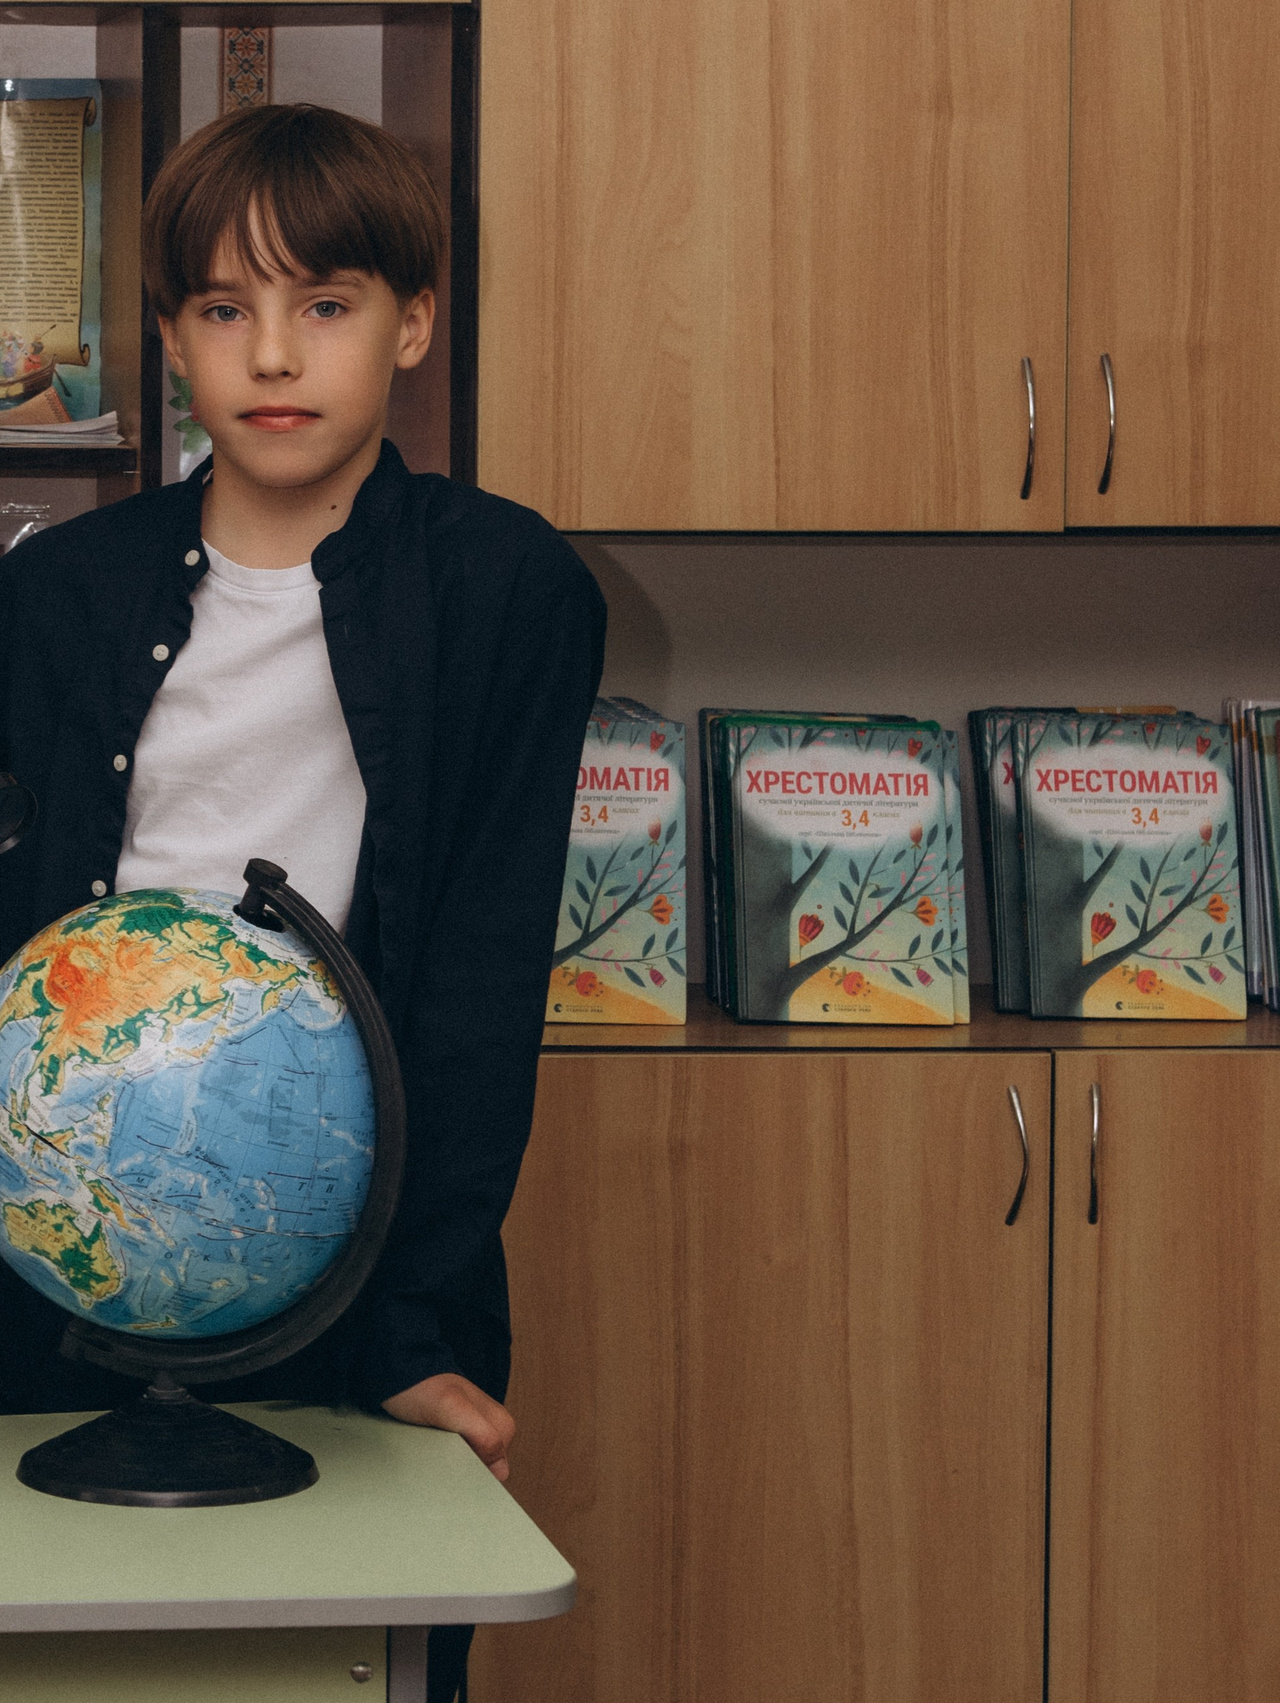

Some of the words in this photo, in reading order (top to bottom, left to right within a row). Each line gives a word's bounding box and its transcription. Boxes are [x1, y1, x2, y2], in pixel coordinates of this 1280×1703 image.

[745, 770, 930, 797] ХРЕСТОМАТІЯ
[1035, 768, 1219, 795] ХРЕСТОМАТІЯ
[579, 804, 609, 827] 3,4
[841, 808, 870, 830] 3,4
[1131, 806, 1160, 828] 3,4
